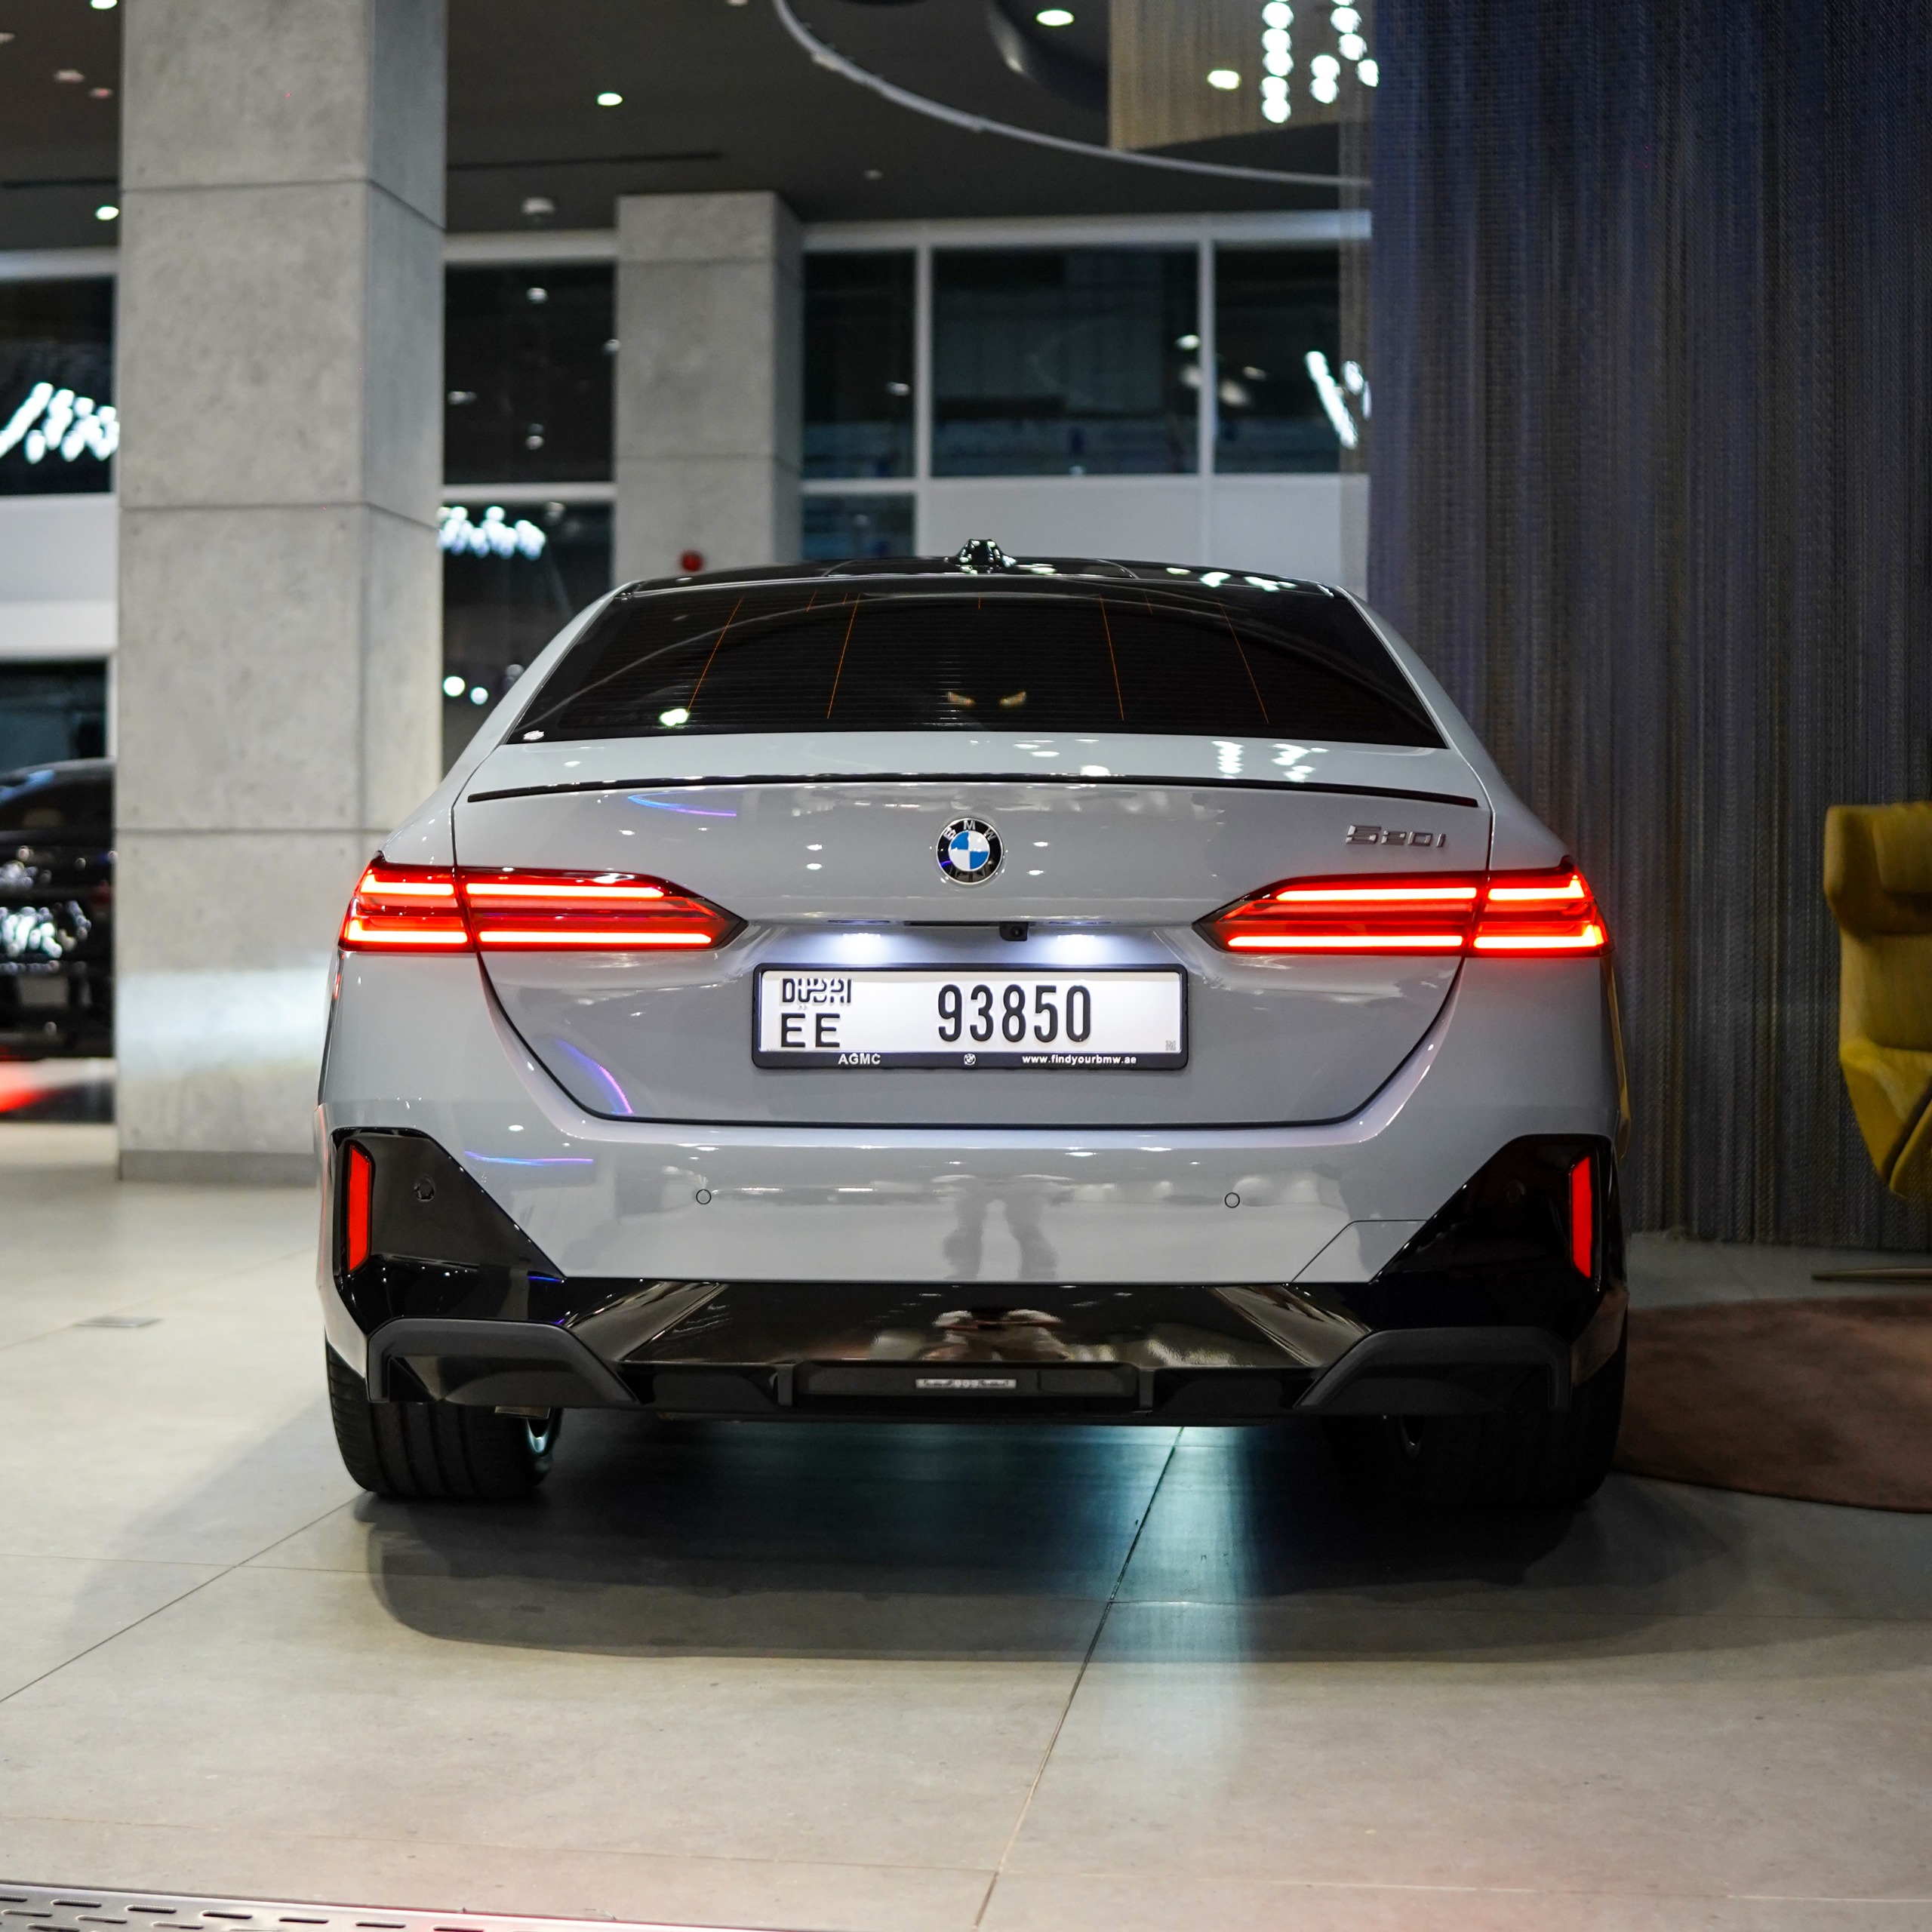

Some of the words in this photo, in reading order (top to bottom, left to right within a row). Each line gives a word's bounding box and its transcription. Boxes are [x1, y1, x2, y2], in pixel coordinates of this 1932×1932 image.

[943, 820, 996, 841] BMW
[782, 978, 852, 1003] DUBAI
[938, 983, 1091, 1043] 93850
[780, 1013, 841, 1048] EE
[838, 1053, 881, 1065] AGMC
[1022, 1054, 1137, 1066] www.findyourbmw.ae
